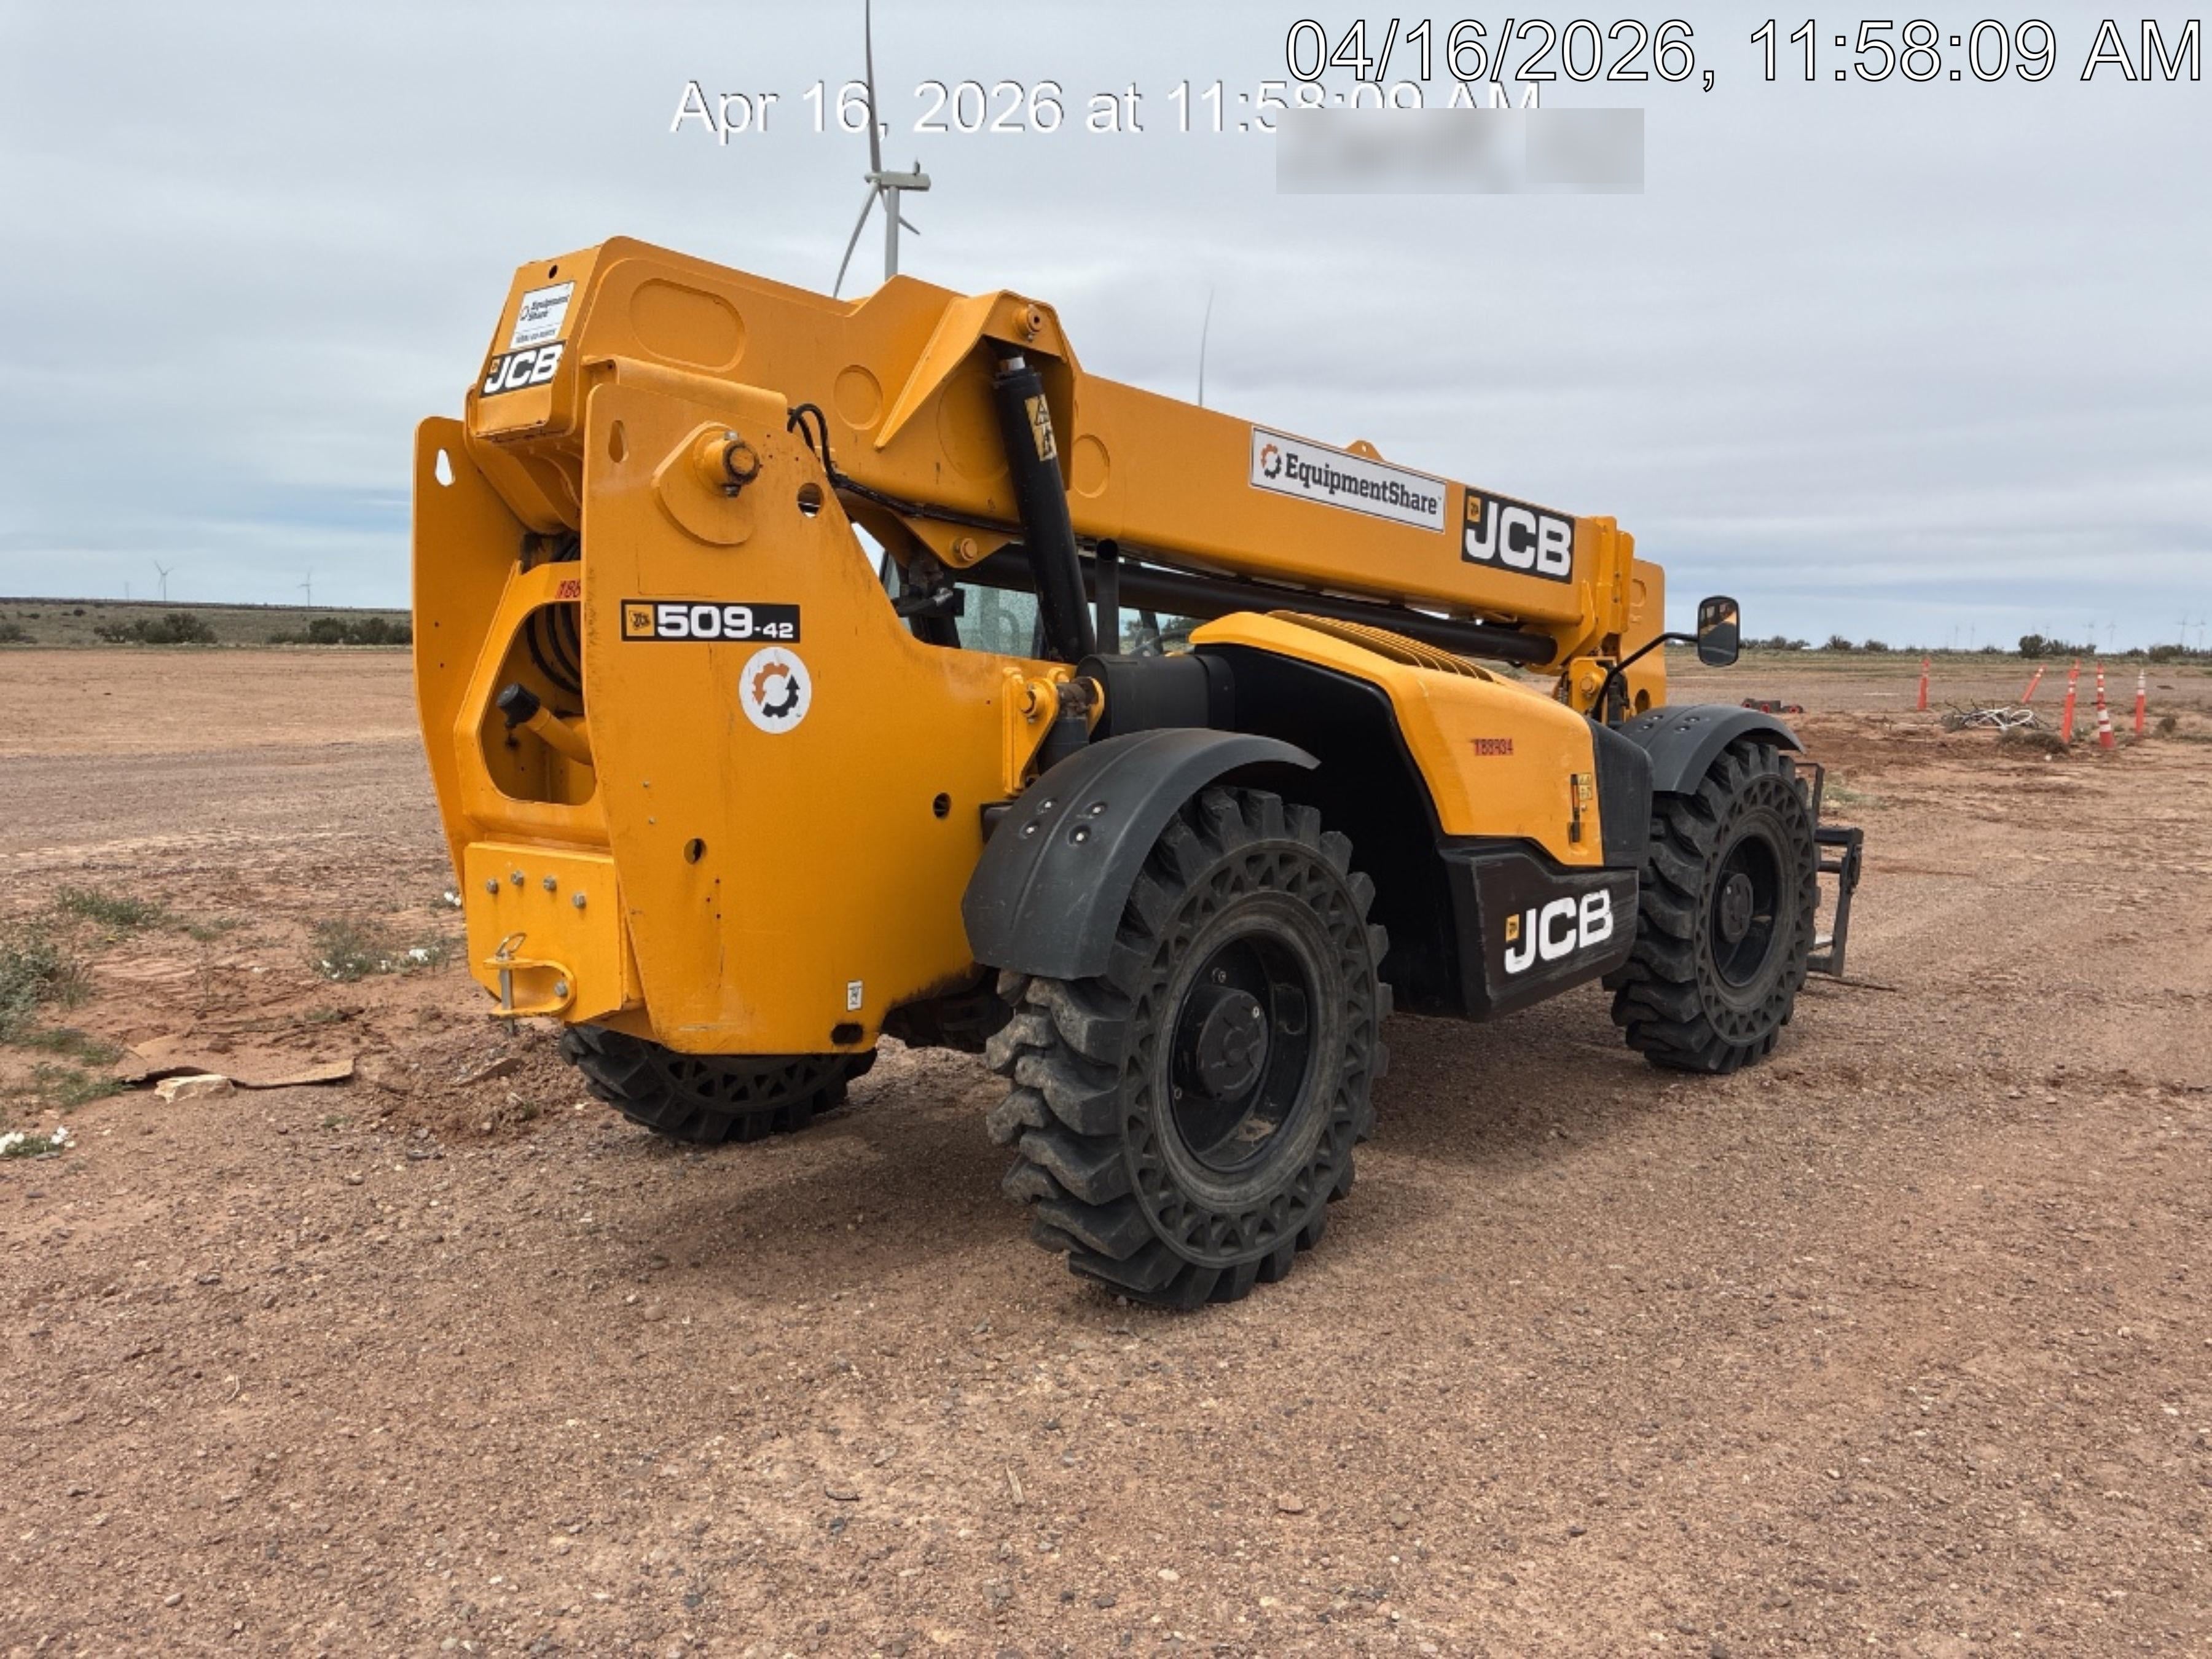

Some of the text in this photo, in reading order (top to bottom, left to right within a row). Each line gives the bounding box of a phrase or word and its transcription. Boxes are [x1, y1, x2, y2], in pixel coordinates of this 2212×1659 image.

[484, 344, 563, 393] JCB
[1285, 452, 1438, 515] EquipmentShare
[1466, 500, 1571, 576] JCB
[657, 605, 794, 639] 509-42
[1505, 888, 1614, 974] JCB
